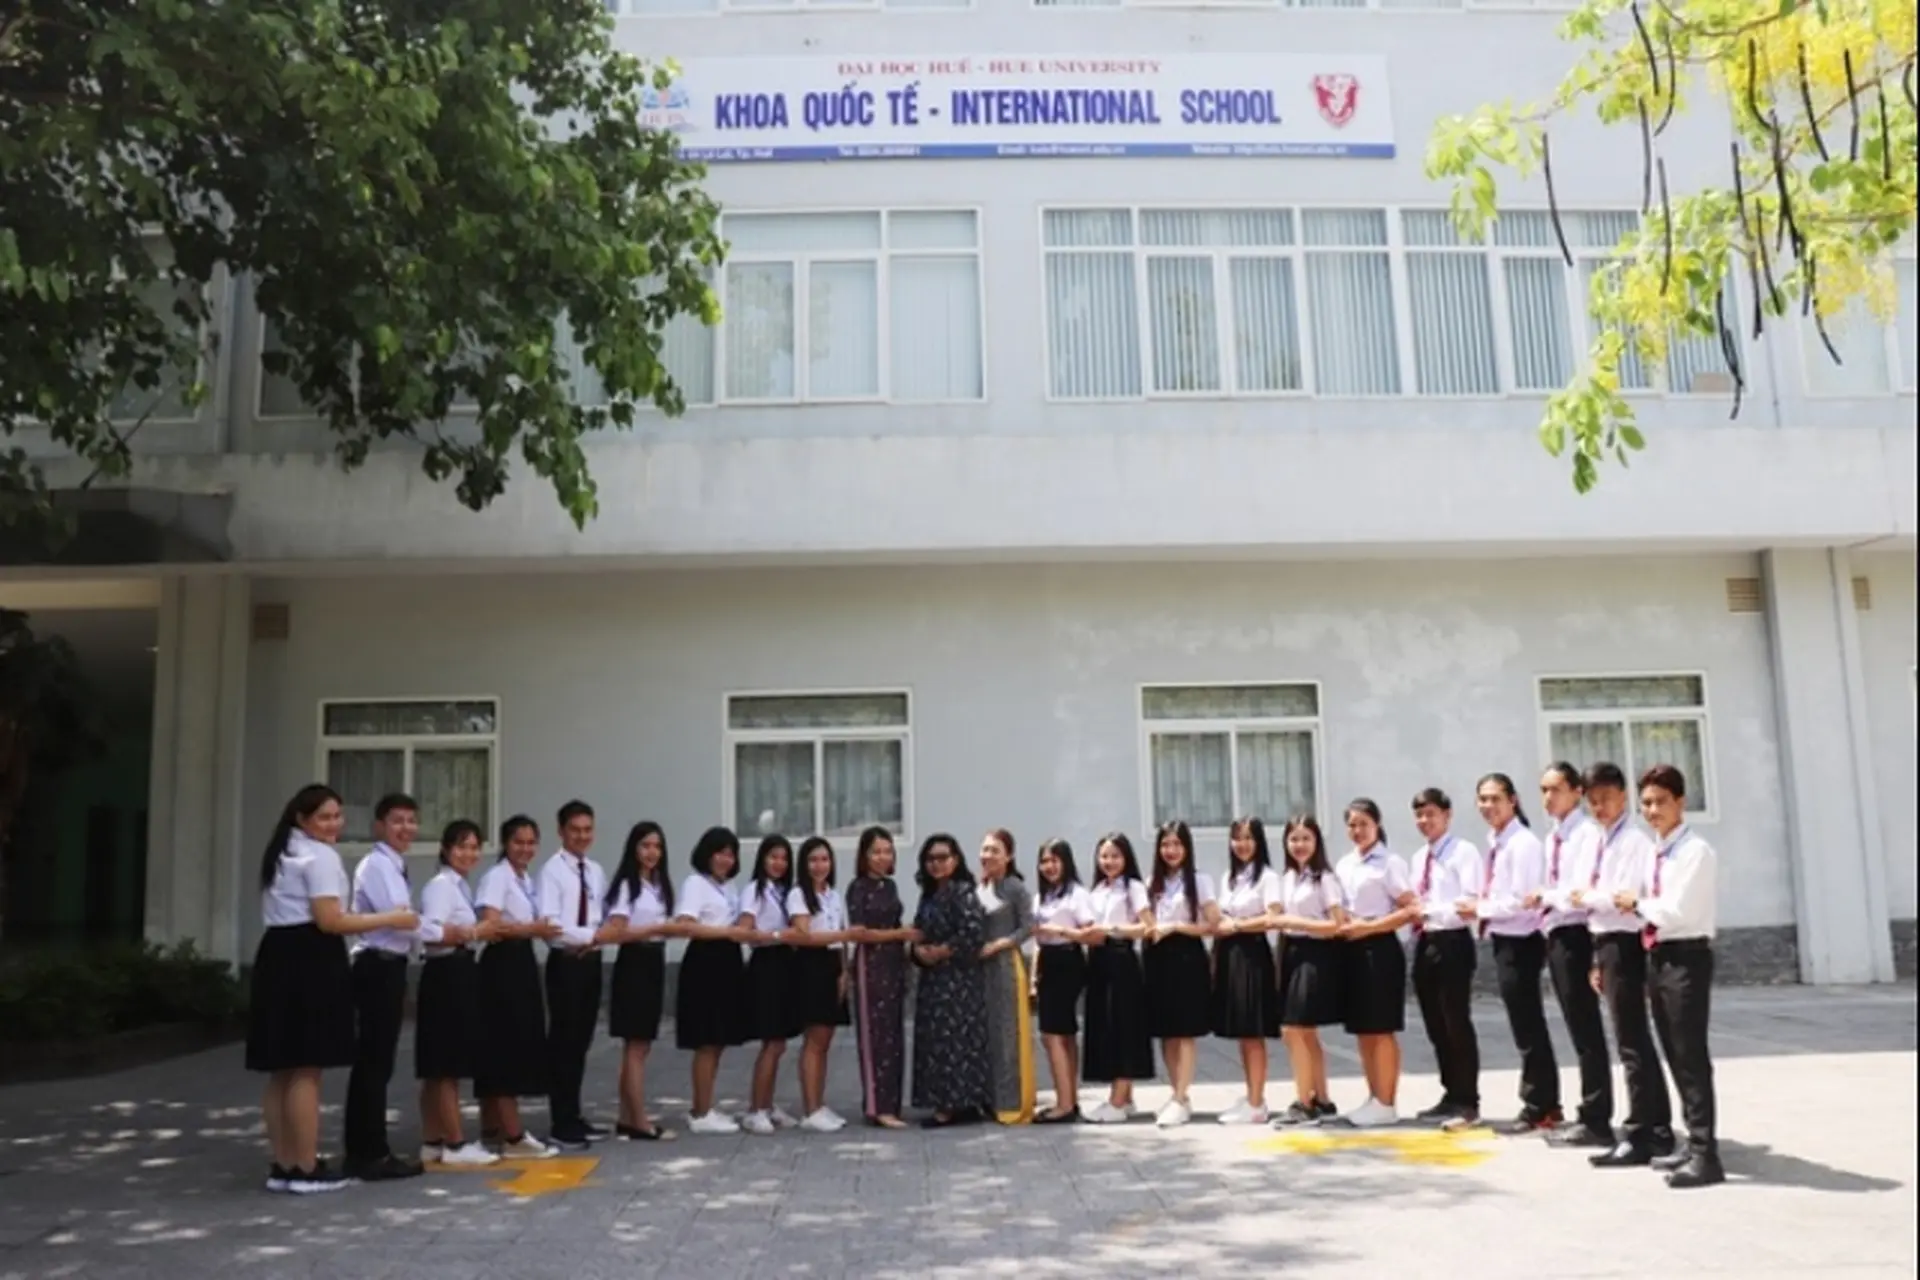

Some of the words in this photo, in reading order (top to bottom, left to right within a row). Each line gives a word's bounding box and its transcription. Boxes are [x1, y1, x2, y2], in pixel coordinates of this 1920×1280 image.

[881, 61, 917, 76] HỌC
[989, 60, 1031, 74] HUE
[1039, 60, 1161, 73] UNIVERSITY
[715, 93, 789, 129] KHOA
[803, 80, 875, 131] QUỐC
[887, 79, 920, 125] TẾ
[951, 89, 1162, 125] INTERNATIONAL
[1180, 89, 1282, 125] SCHOOL
